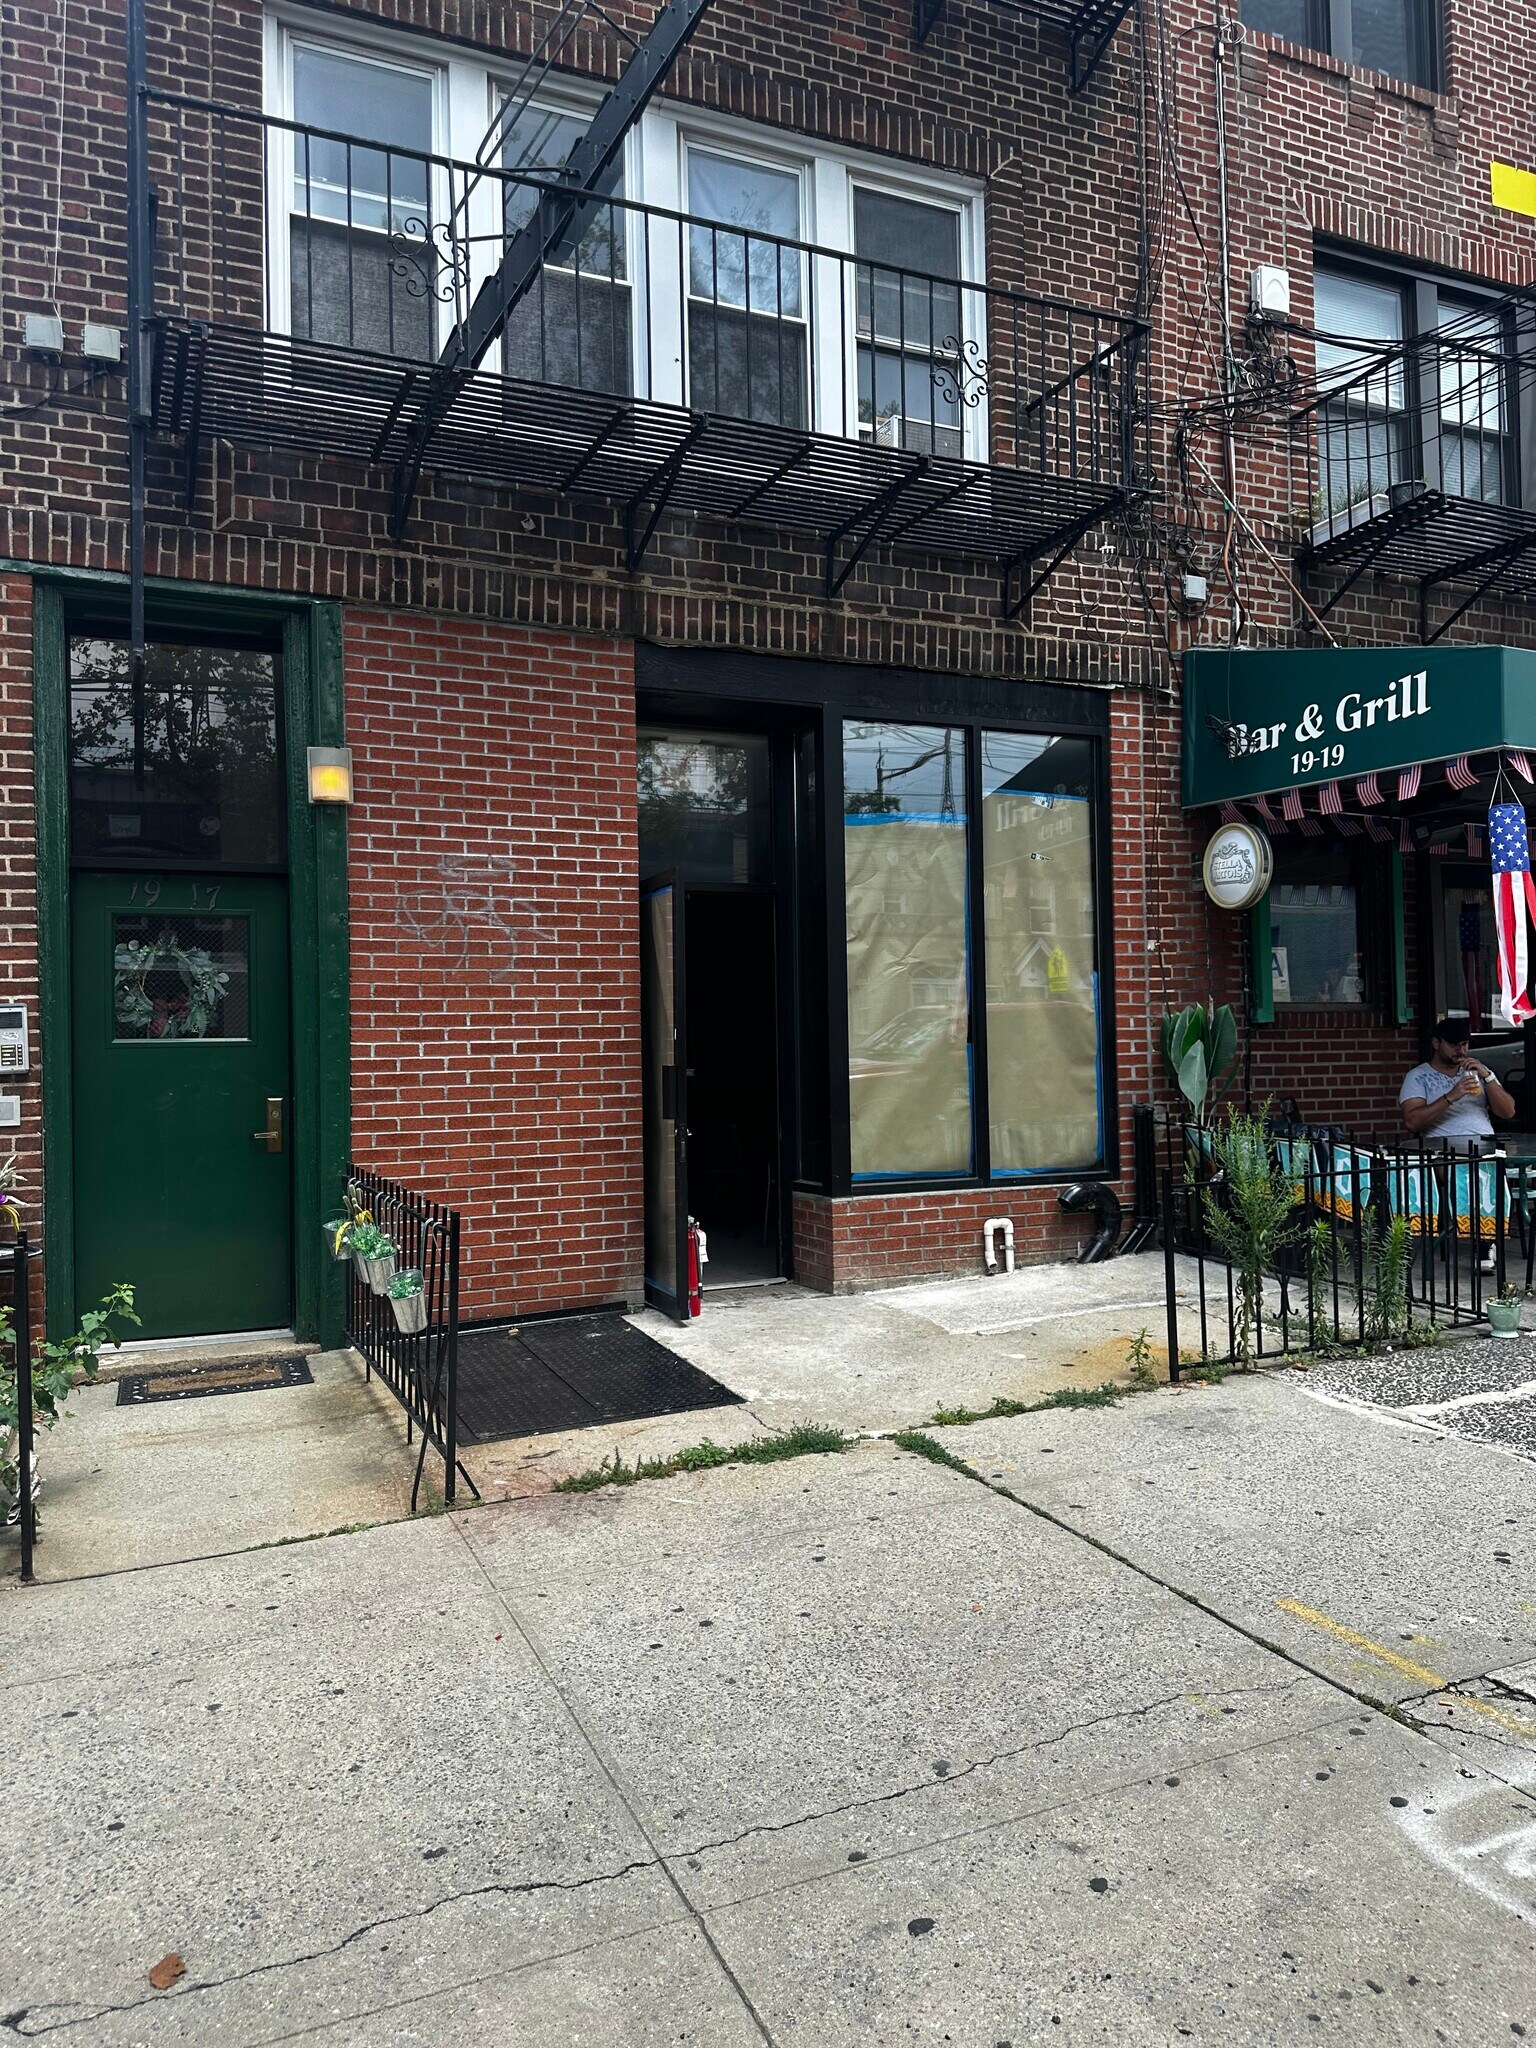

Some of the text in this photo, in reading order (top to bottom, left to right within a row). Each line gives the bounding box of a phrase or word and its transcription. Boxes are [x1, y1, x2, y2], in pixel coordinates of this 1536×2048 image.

[1228, 670, 1431, 758] Bar & Grill
[1290, 744, 1345, 774] 19-19
[1213, 859, 1243, 870] STELLA
[127, 879, 222, 911] 19 17
